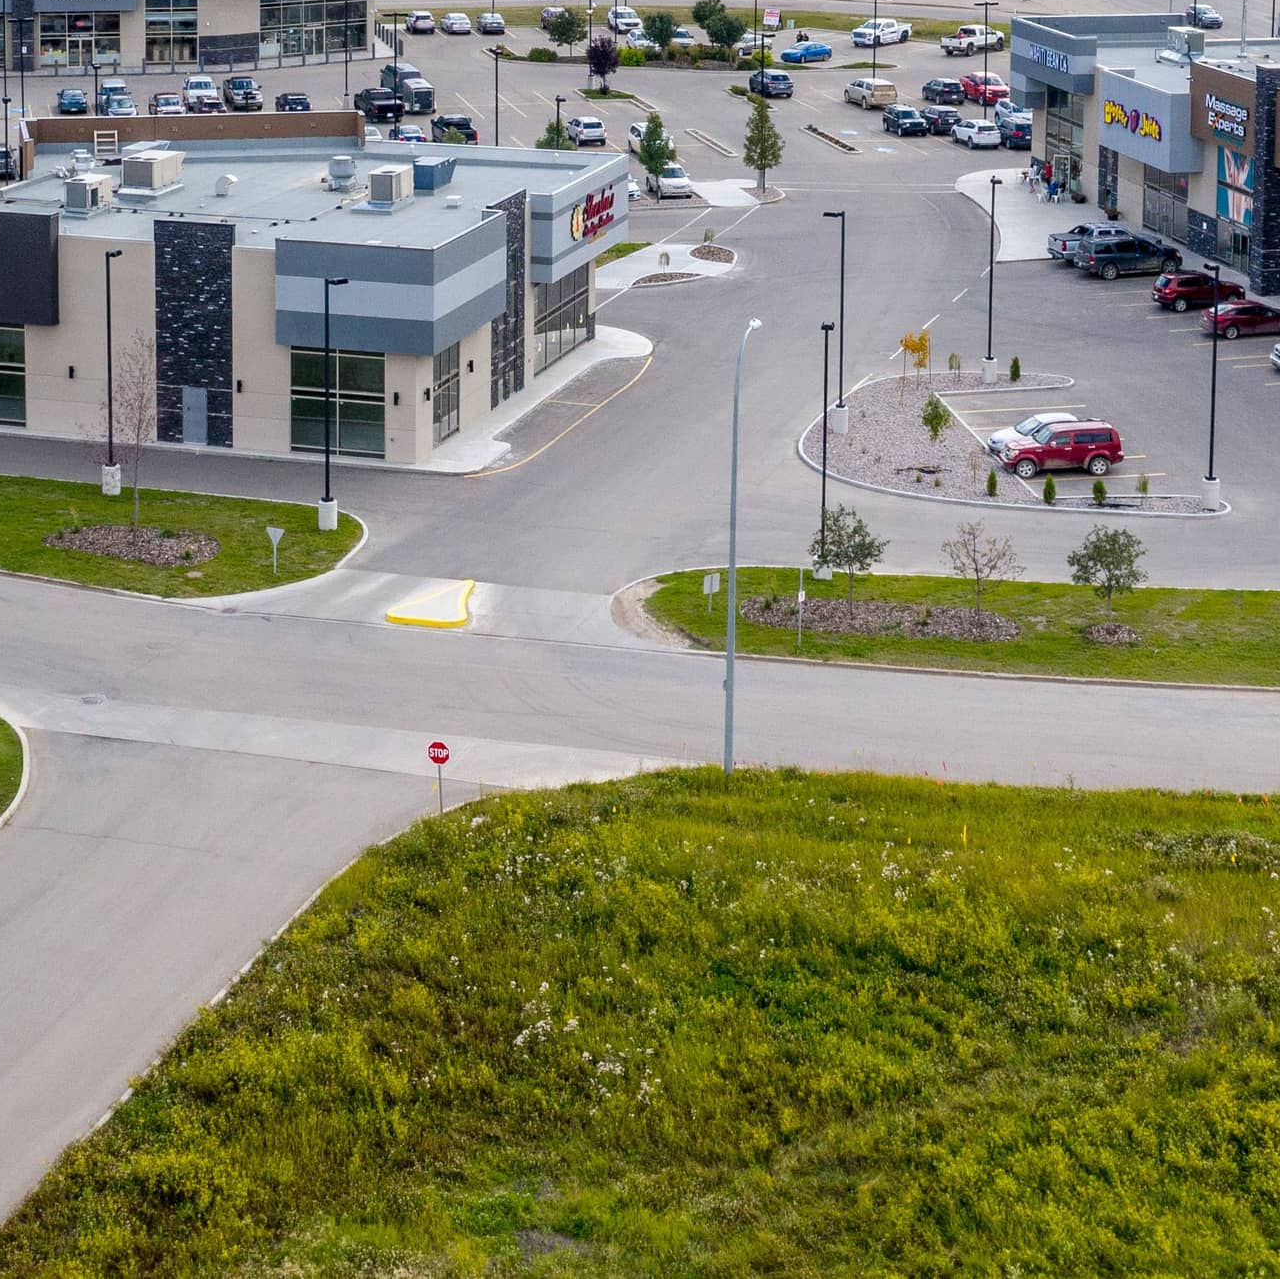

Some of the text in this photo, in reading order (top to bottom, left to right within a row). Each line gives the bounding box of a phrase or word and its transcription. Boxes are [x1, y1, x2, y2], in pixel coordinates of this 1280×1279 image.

[1205, 93, 1248, 122] Massage
[1208, 111, 1245, 137] Experts
[429, 748, 448, 758] STOP
